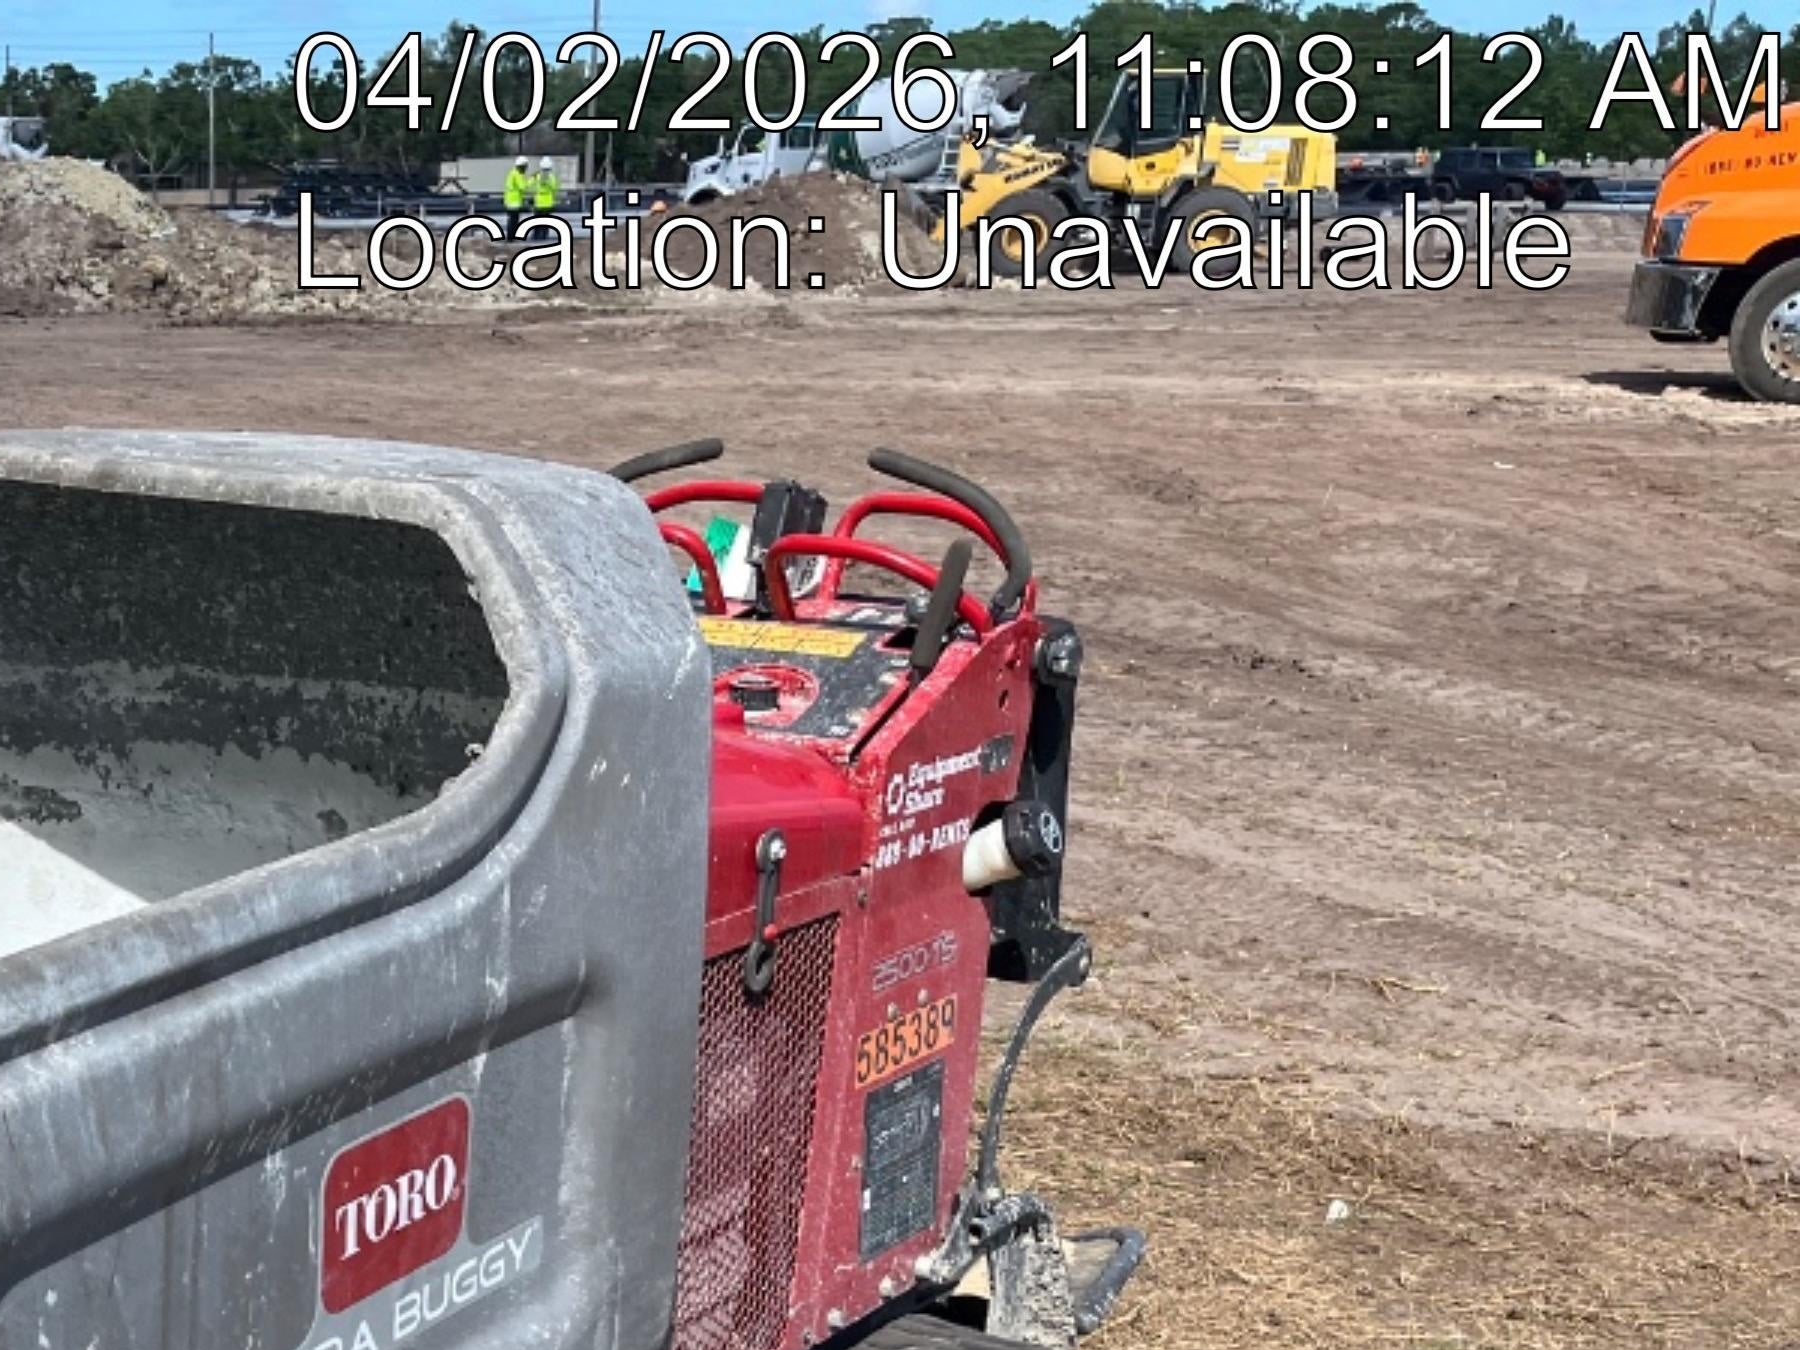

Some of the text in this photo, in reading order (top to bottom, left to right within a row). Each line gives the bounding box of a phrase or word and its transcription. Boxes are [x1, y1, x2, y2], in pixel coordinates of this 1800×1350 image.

[908, 745, 982, 789] Equipment
[856, 997, 955, 1084] 585389
[335, 1153, 457, 1261] TORO
[392, 1226, 534, 1341] BUGGY
